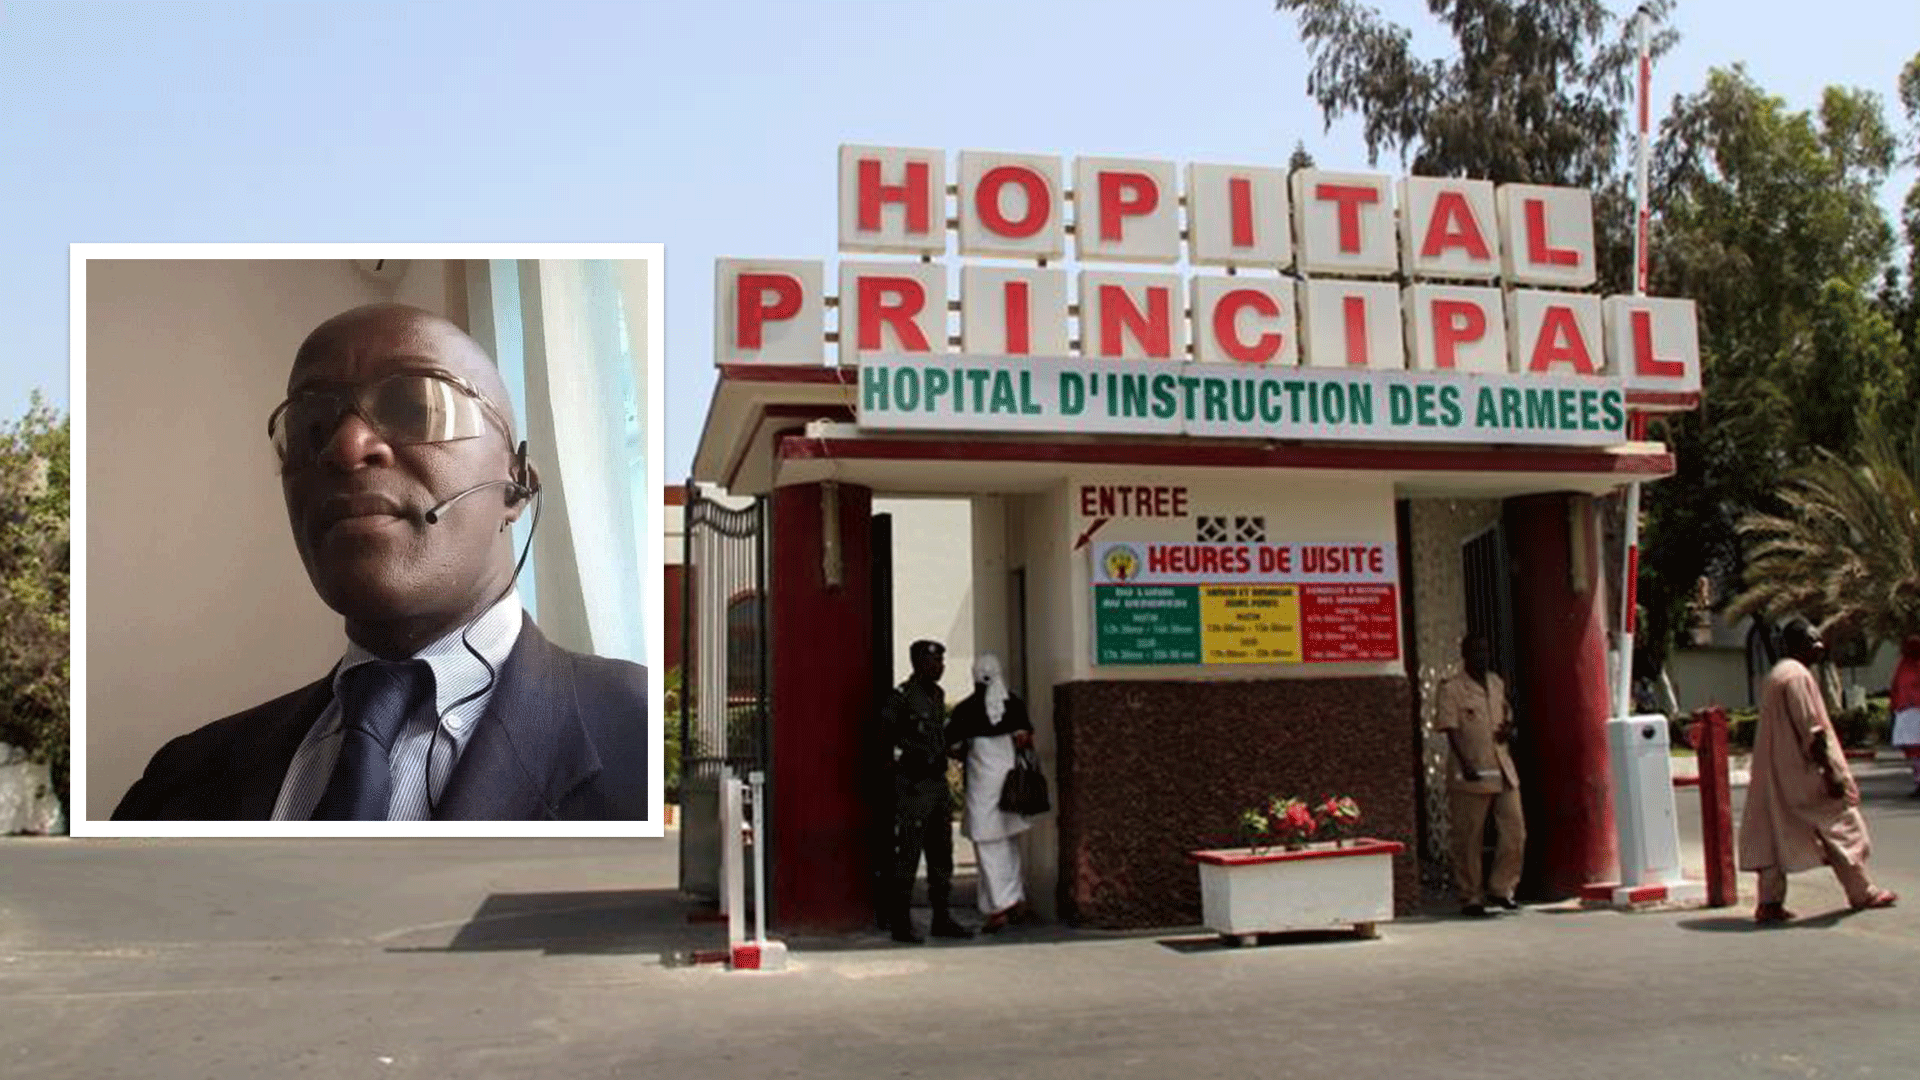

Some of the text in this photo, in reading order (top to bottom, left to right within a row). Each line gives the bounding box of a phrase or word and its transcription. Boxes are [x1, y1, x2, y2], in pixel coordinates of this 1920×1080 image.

[857, 159, 1579, 266] HOPITAL
[736, 273, 1685, 376] PRINCIPAL
[863, 366, 1624, 431] HOPITAL D'INSTRUCTION DES ARMEES
[1081, 486, 1188, 517] ENTREE
[1148, 545, 1384, 574] HEURES DE VISITE
